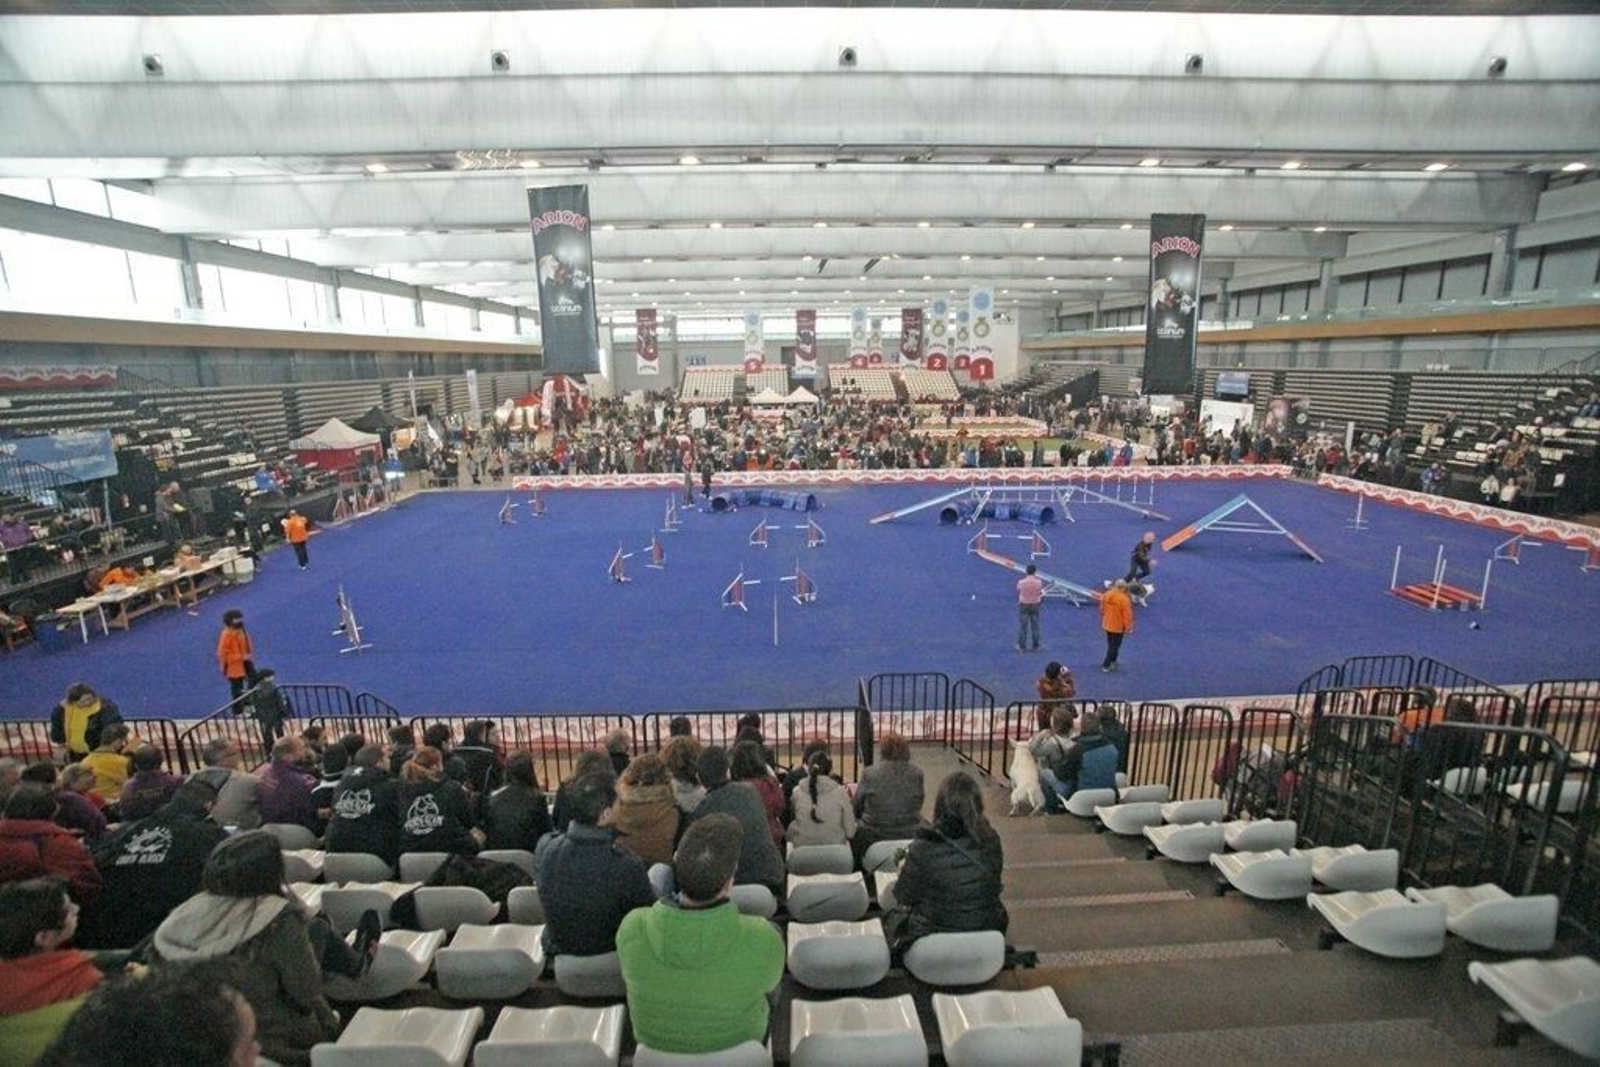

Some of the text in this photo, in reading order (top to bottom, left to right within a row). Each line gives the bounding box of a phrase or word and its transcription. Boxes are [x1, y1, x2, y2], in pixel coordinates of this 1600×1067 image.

[532, 210, 589, 236] ARION
[1151, 236, 1201, 259] ARION
[933, 358, 941, 368] 2
[979, 365, 985, 376] 1
